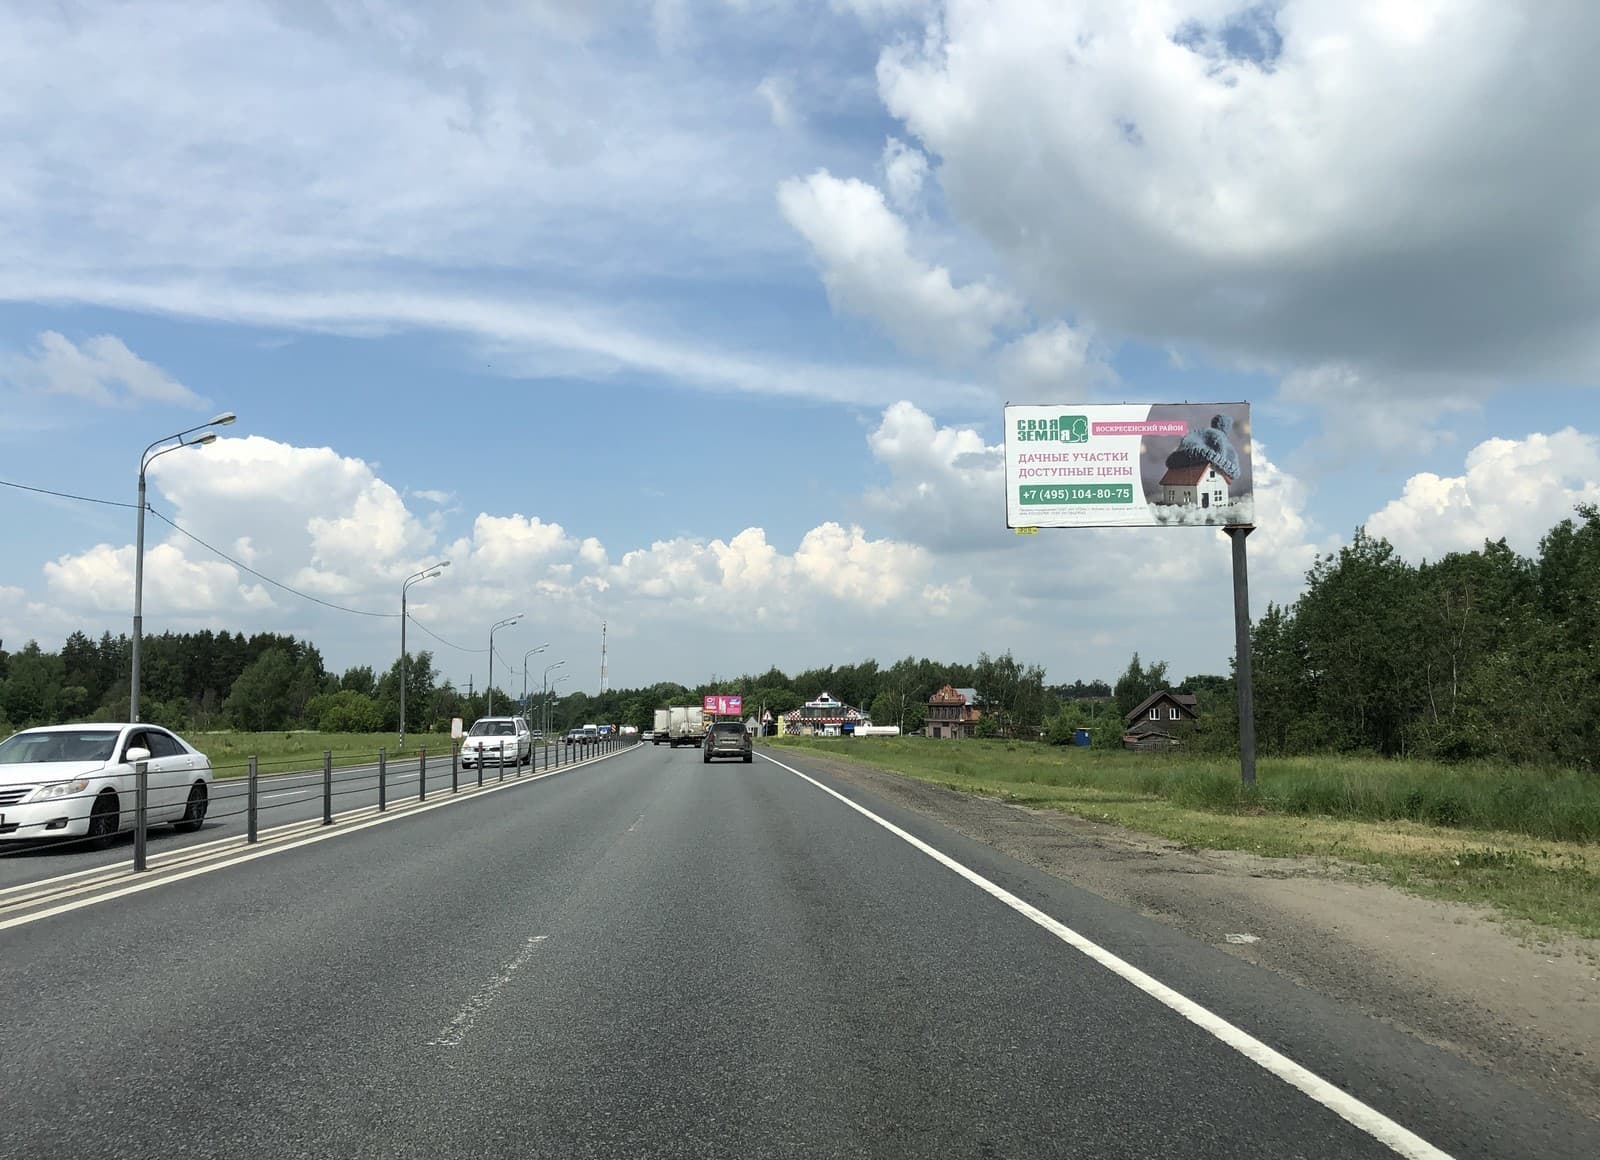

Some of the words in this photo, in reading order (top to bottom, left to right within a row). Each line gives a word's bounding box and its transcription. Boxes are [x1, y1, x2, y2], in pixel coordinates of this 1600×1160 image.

[1017, 419, 1058, 430] СВОЯ
[1096, 423, 1158, 432] ВОСКРЕСЕНСКИЙ
[1160, 423, 1184, 432] РАЙОН
[1017, 430, 1070, 441] ЗЕМЛЯ
[1018, 453, 1069, 464] ДАЧНЫЕ
[1073, 452, 1129, 462] УЧАСТКИ
[1018, 467, 1094, 479] ДОСТУПНЫЕ
[1097, 466, 1133, 477] ЦЕНЫ
[1023, 490, 1037, 499] +7
[1039, 489, 1069, 501] (495)
[1072, 488, 1130, 499] 104-80-75
